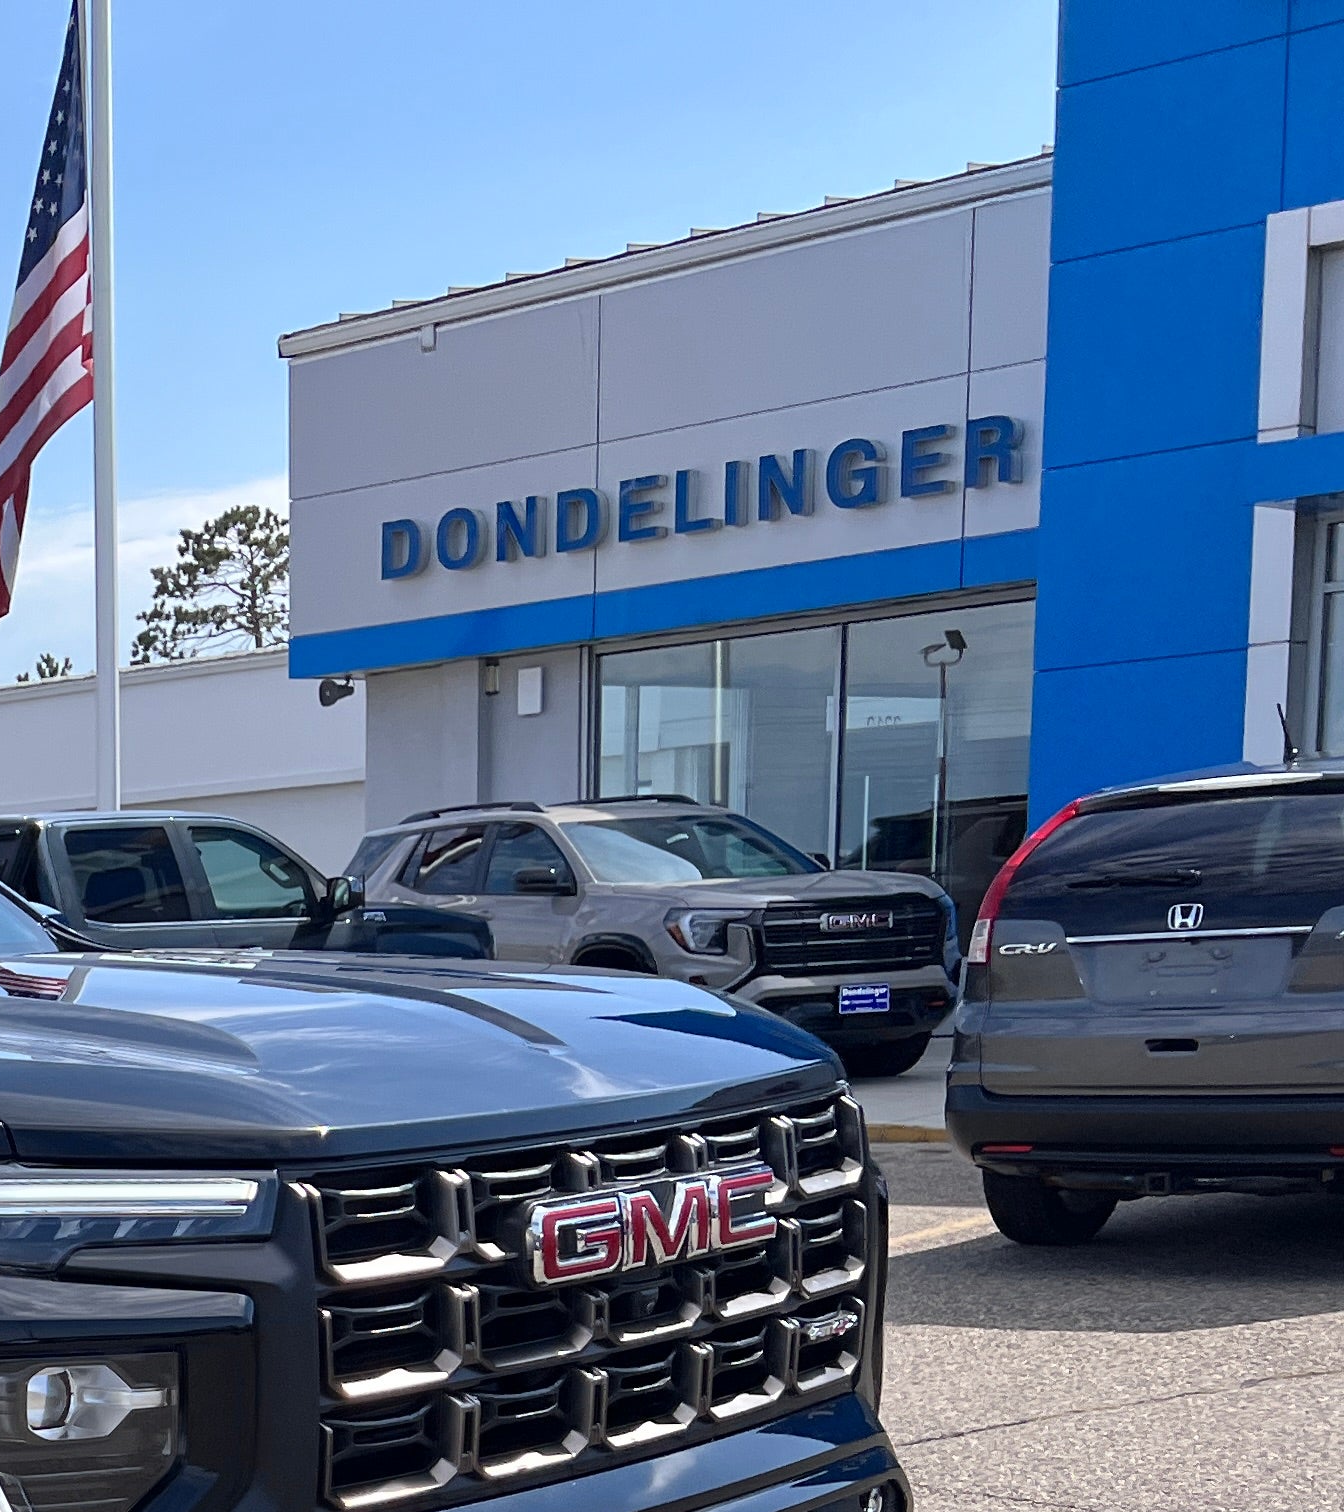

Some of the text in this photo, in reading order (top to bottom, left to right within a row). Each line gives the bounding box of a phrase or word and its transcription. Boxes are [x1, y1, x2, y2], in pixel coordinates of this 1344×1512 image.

[380, 415, 1023, 581] DONDELINGER
[828, 913, 891, 929] GMC
[999, 942, 1058, 955] CR-V
[531, 1164, 778, 1285] GMC
